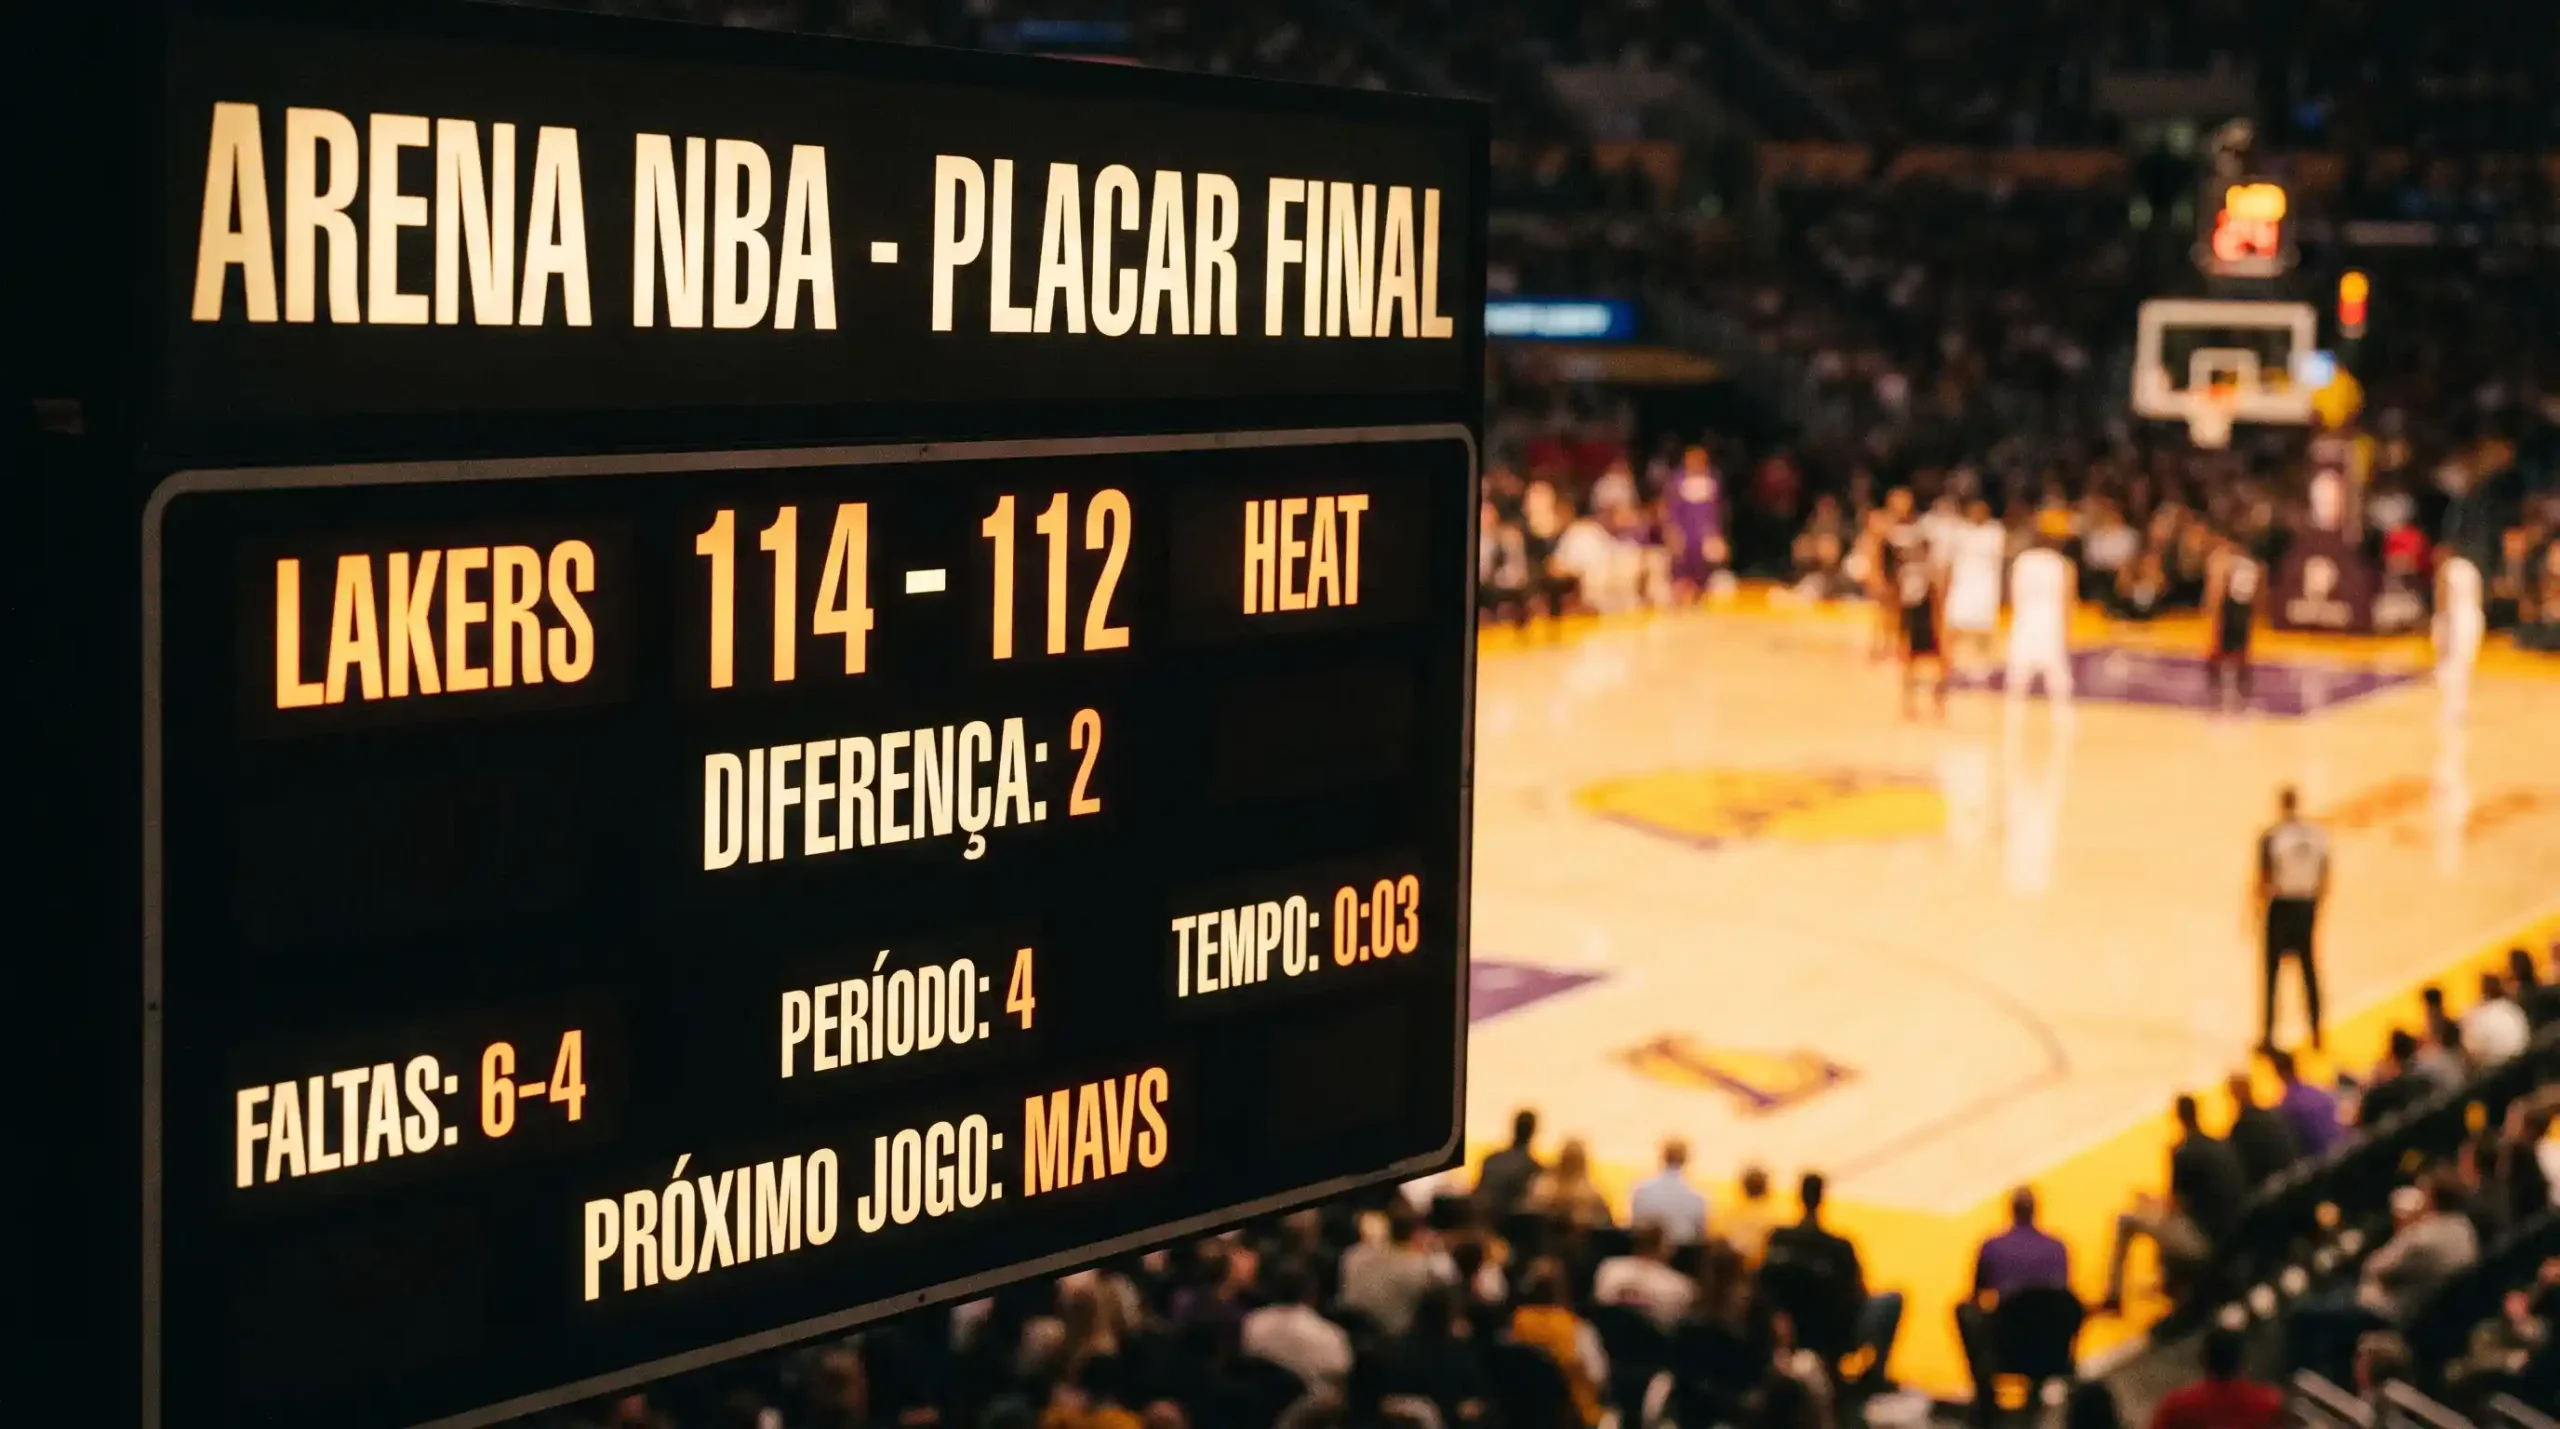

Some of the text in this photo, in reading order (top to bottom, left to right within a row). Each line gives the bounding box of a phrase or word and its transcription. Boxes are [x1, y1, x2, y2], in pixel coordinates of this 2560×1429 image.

[192, 102, 592, 326] ARENA
[634, 133, 837, 329] NBA
[931, 155, 1240, 336] PLACAR
[1265, 178, 1454, 338] FINAL
[276, 540, 595, 709] LAKERS
[695, 503, 875, 688] 114
[982, 489, 1132, 660] 112
[1243, 494, 1369, 614] HEAT
[703, 709, 1101, 870] DIFERENÇA: 2
[782, 948, 1035, 1078] PERÍODO: 4
[1171, 875, 1420, 997] TEMPO: 0:03
[236, 1055, 458, 1188] FALTAS:
[585, 1067, 1168, 1301] PRÓXIMO JOGO: MAVS
